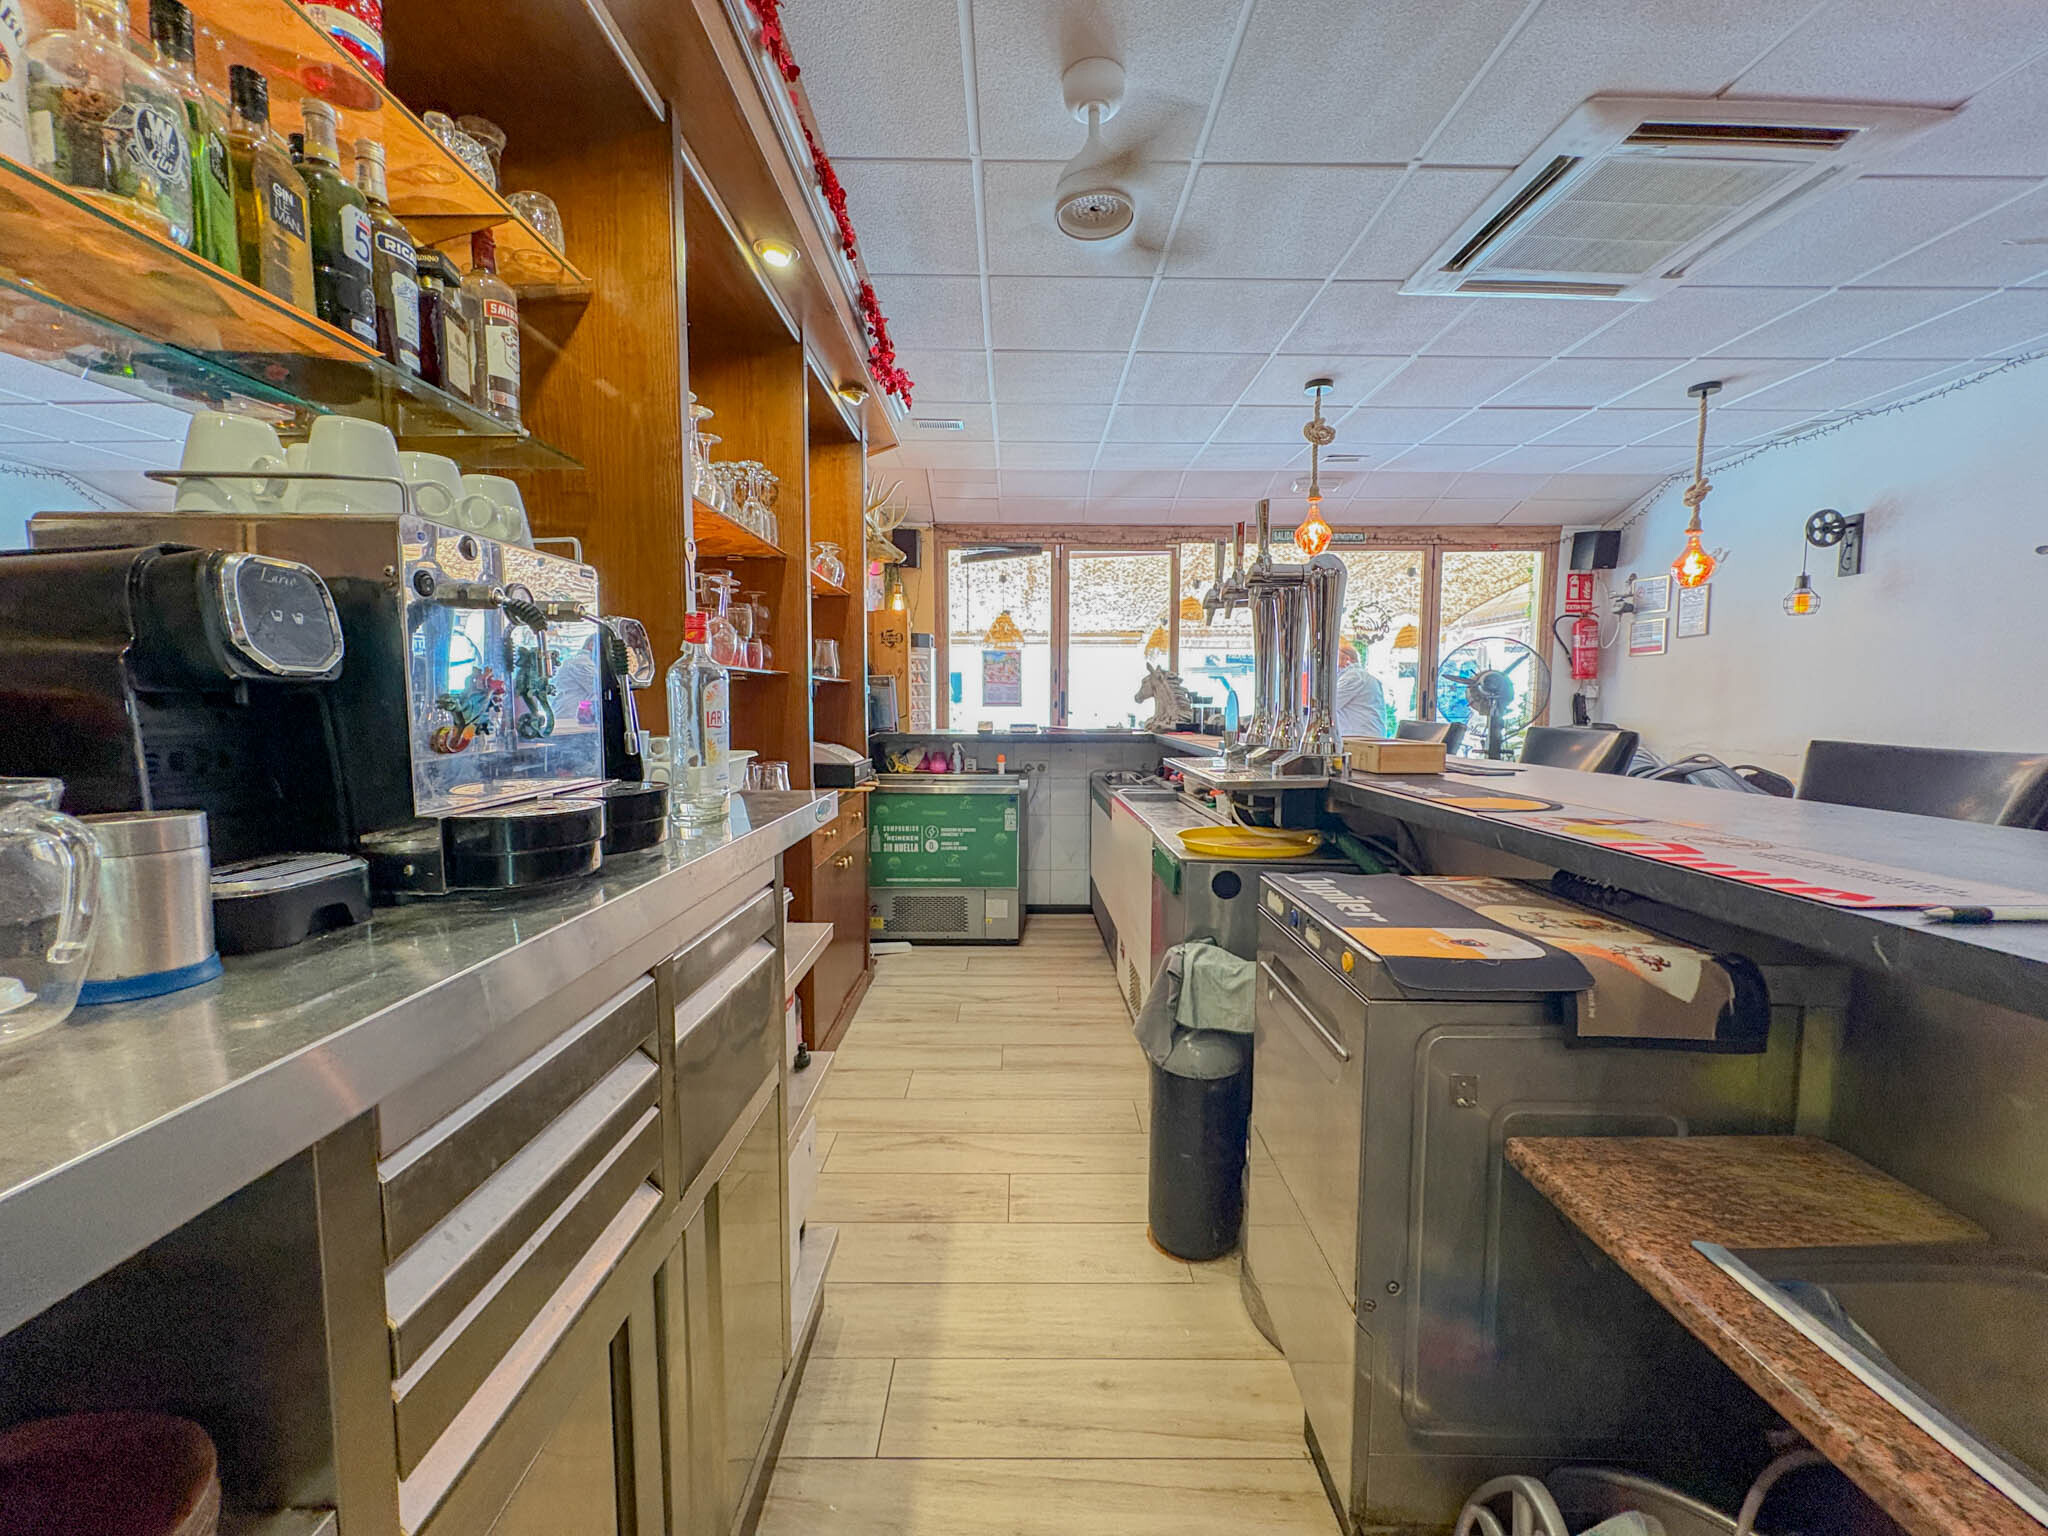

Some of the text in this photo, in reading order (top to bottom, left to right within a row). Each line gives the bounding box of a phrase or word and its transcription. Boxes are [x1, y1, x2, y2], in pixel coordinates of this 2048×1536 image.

[272, 182, 295, 207] GIN
[894, 843, 919, 853] HUELLA
[1285, 875, 1389, 923] Jupiler
